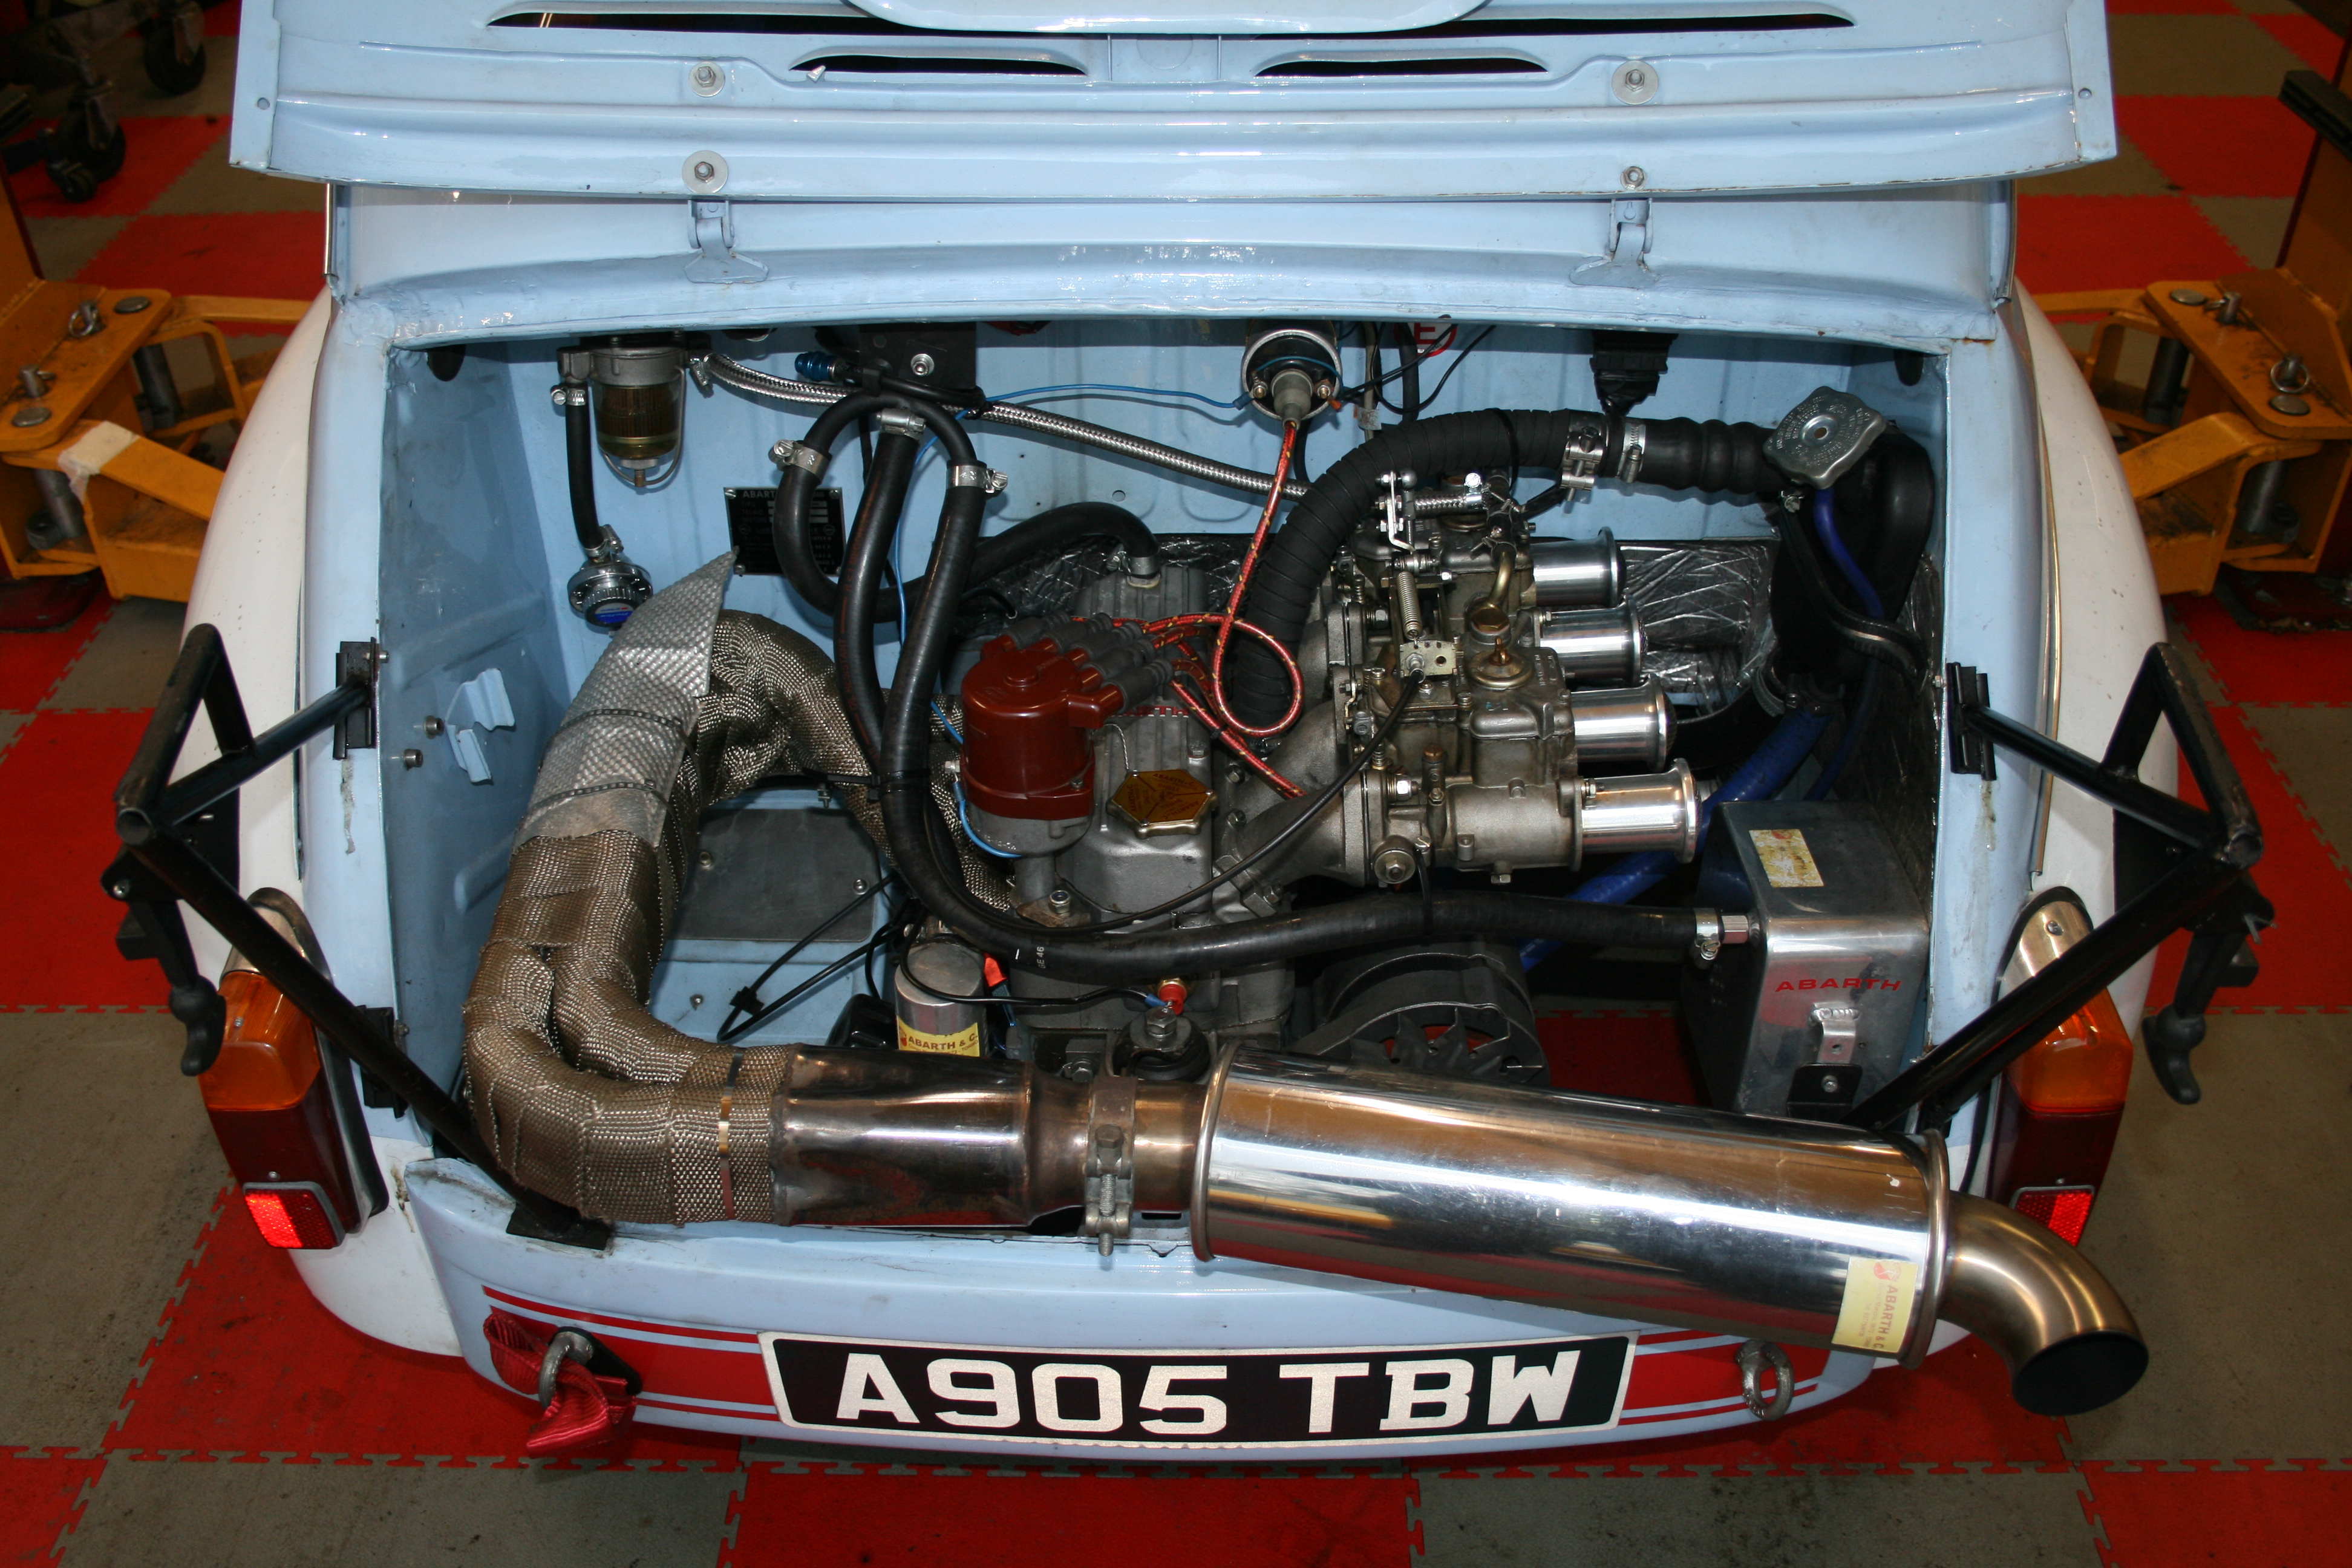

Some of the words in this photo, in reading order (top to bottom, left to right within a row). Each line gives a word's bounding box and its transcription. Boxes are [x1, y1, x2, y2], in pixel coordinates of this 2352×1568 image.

[1036, 946, 1045, 958] 46
[1775, 978, 1901, 992] ABARTH
[909, 1036, 956, 1050] ABARTH
[1878, 1285, 1898, 1334] ABARTH
[835, 1353, 1227, 1436] A905
[1278, 1350, 1580, 1434] TBW
